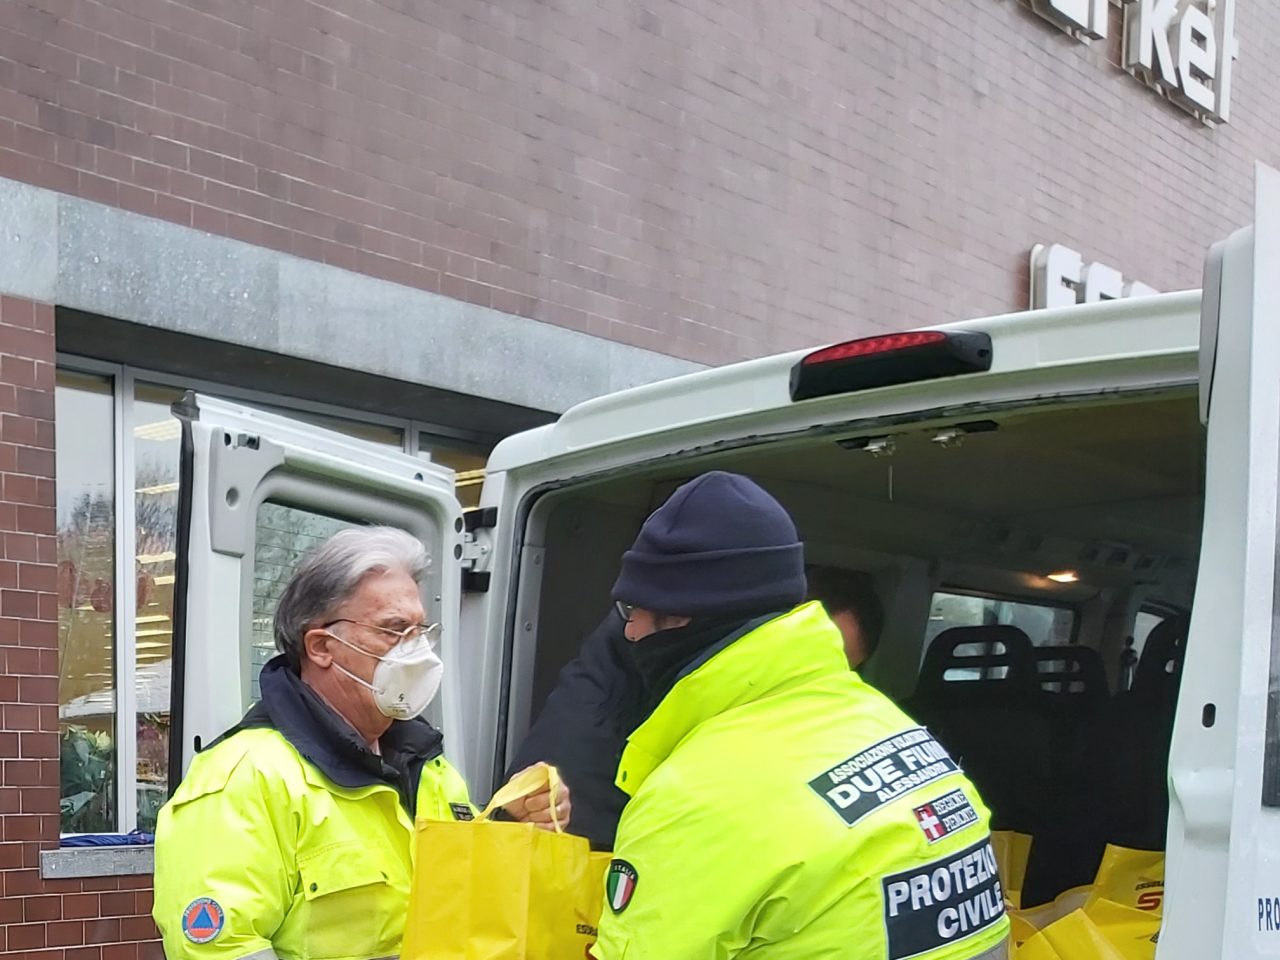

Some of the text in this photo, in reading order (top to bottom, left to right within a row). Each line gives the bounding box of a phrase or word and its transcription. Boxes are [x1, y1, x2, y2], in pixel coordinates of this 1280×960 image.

[828, 741, 898, 784] ASSOCIAZIONE
[826, 758, 904, 809] DUE
[932, 790, 968, 816] REGIONE
[614, 864, 635, 880] ITALIA
[937, 880, 1004, 938] CIVILE
[1258, 896, 1280, 931] PRO
